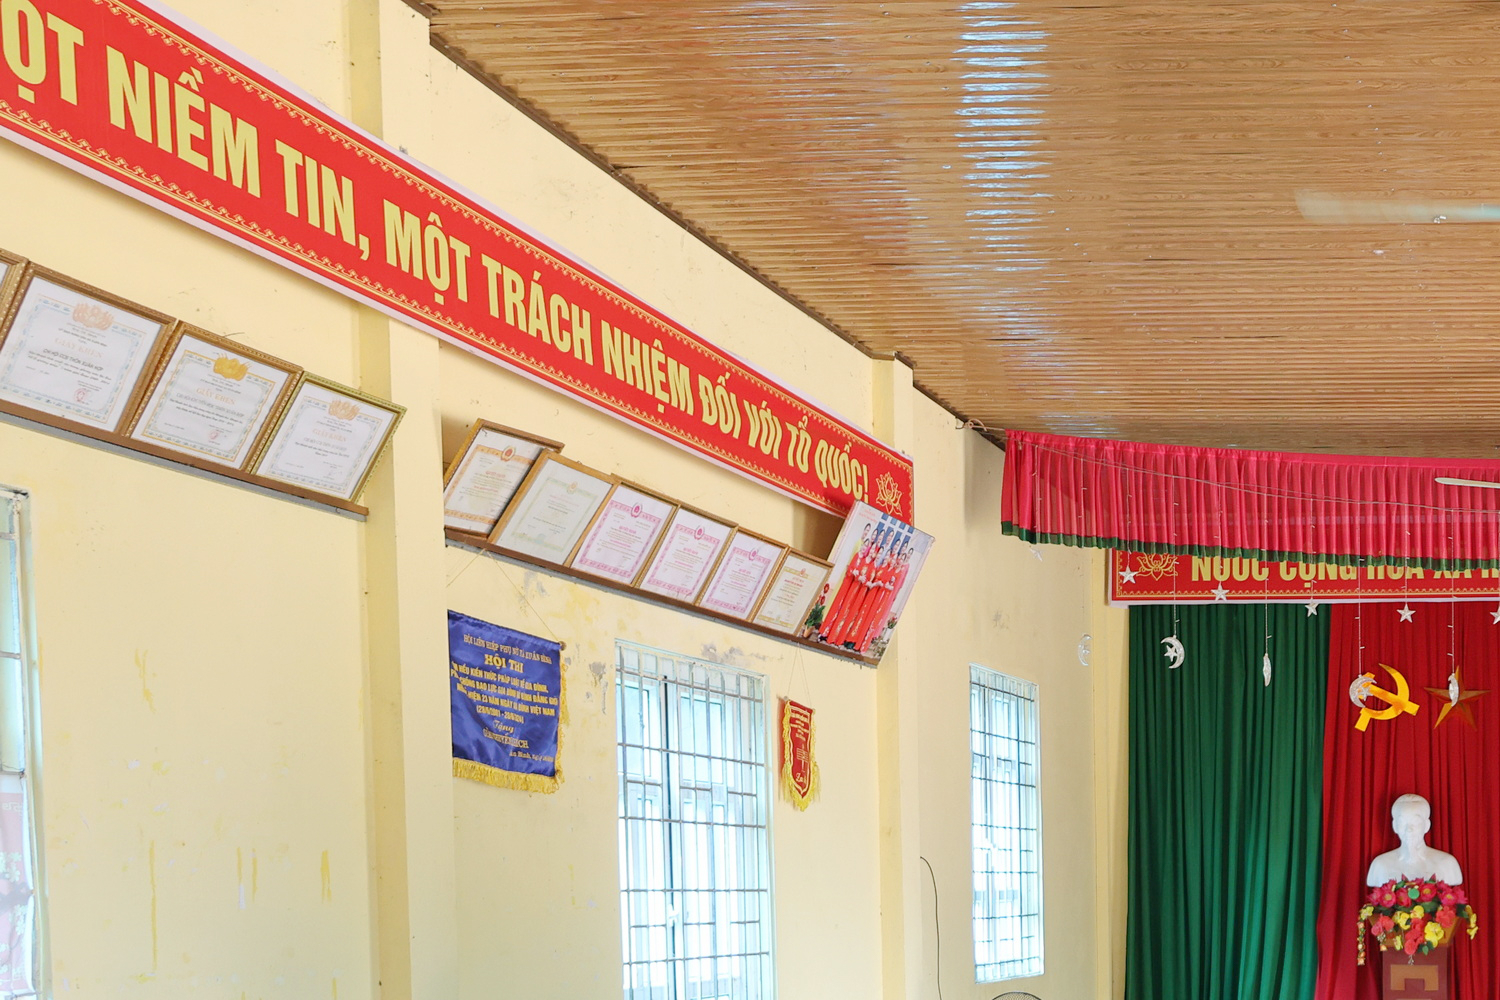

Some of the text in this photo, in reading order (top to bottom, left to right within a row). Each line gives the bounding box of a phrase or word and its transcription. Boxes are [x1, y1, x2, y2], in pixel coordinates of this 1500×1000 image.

[106, 45, 261, 199] NIỀM
[275, 139, 371, 261] TIN,
[383, 199, 471, 306] MỘT
[482, 256, 594, 366] TRÁCH
[601, 321, 695, 416] NHIỆM
[698, 371, 741, 440] ĐỐI
[743, 399, 782, 460] VỚI
[785, 415, 812, 473] TỔ
[814, 439, 869, 503] QUỐC!
[484, 653, 524, 673] HỘI THI
